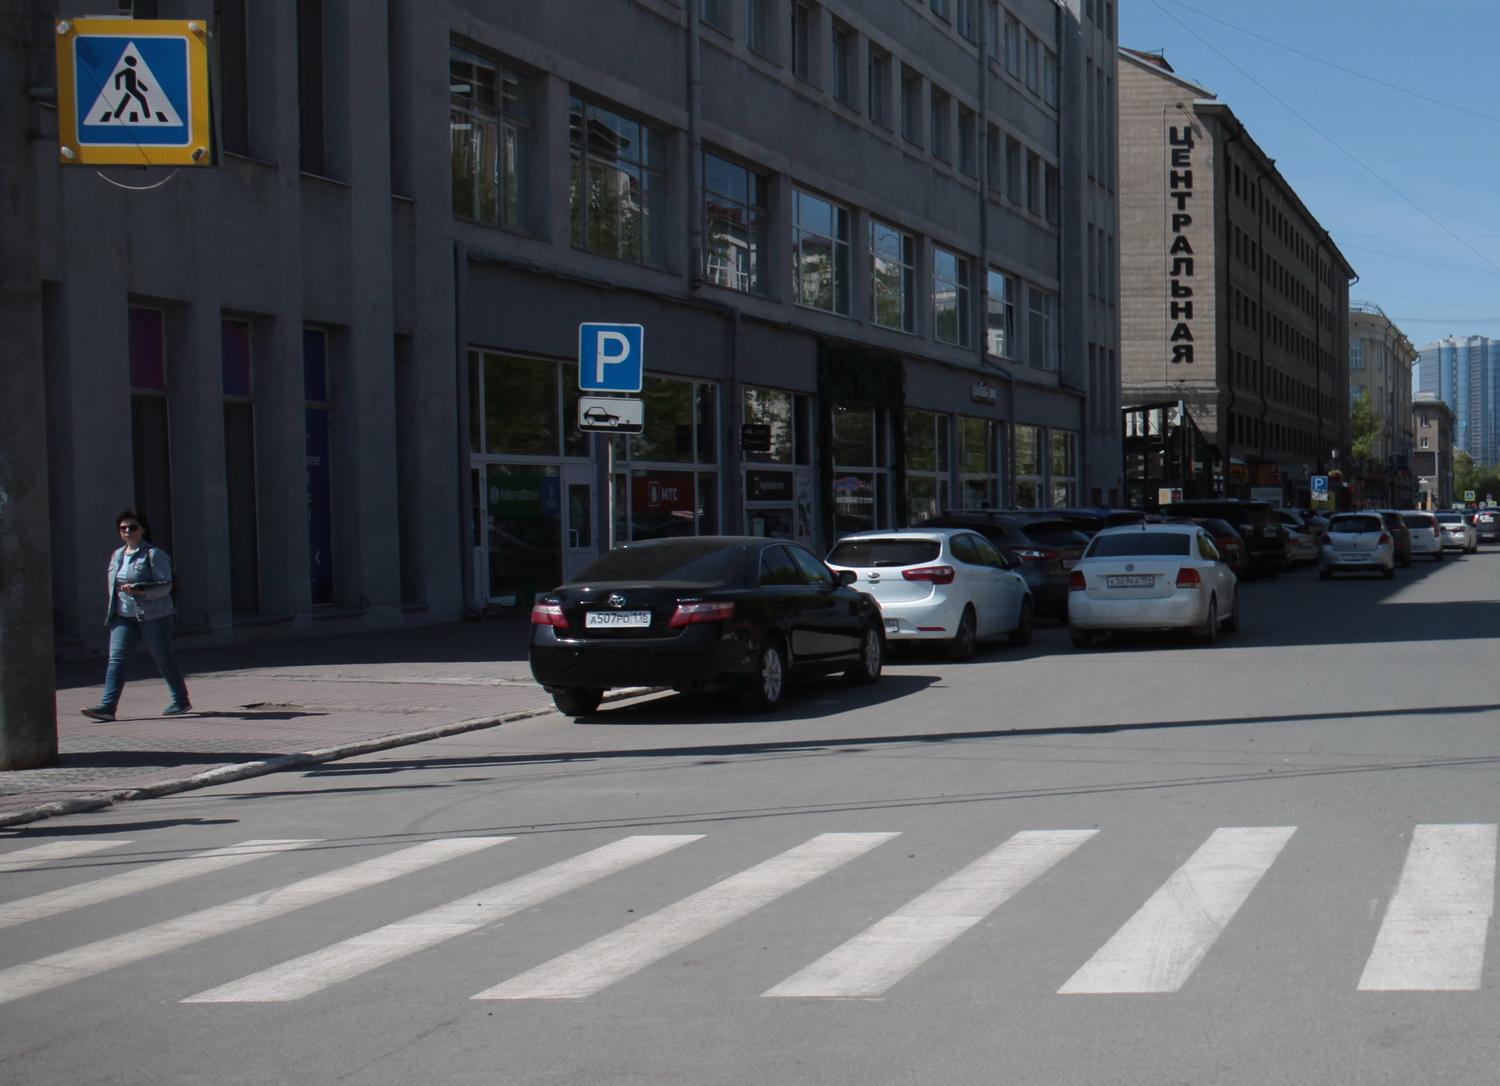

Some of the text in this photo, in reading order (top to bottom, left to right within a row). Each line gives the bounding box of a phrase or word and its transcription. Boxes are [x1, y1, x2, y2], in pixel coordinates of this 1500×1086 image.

[1169, 126, 1194, 363] ЦЕНТРАЛЬНАЯ
[596, 331, 630, 383] P
[1314, 478, 1324, 490] P
[661, 486, 679, 502] МТС
[590, 612, 630, 624] А507РО
